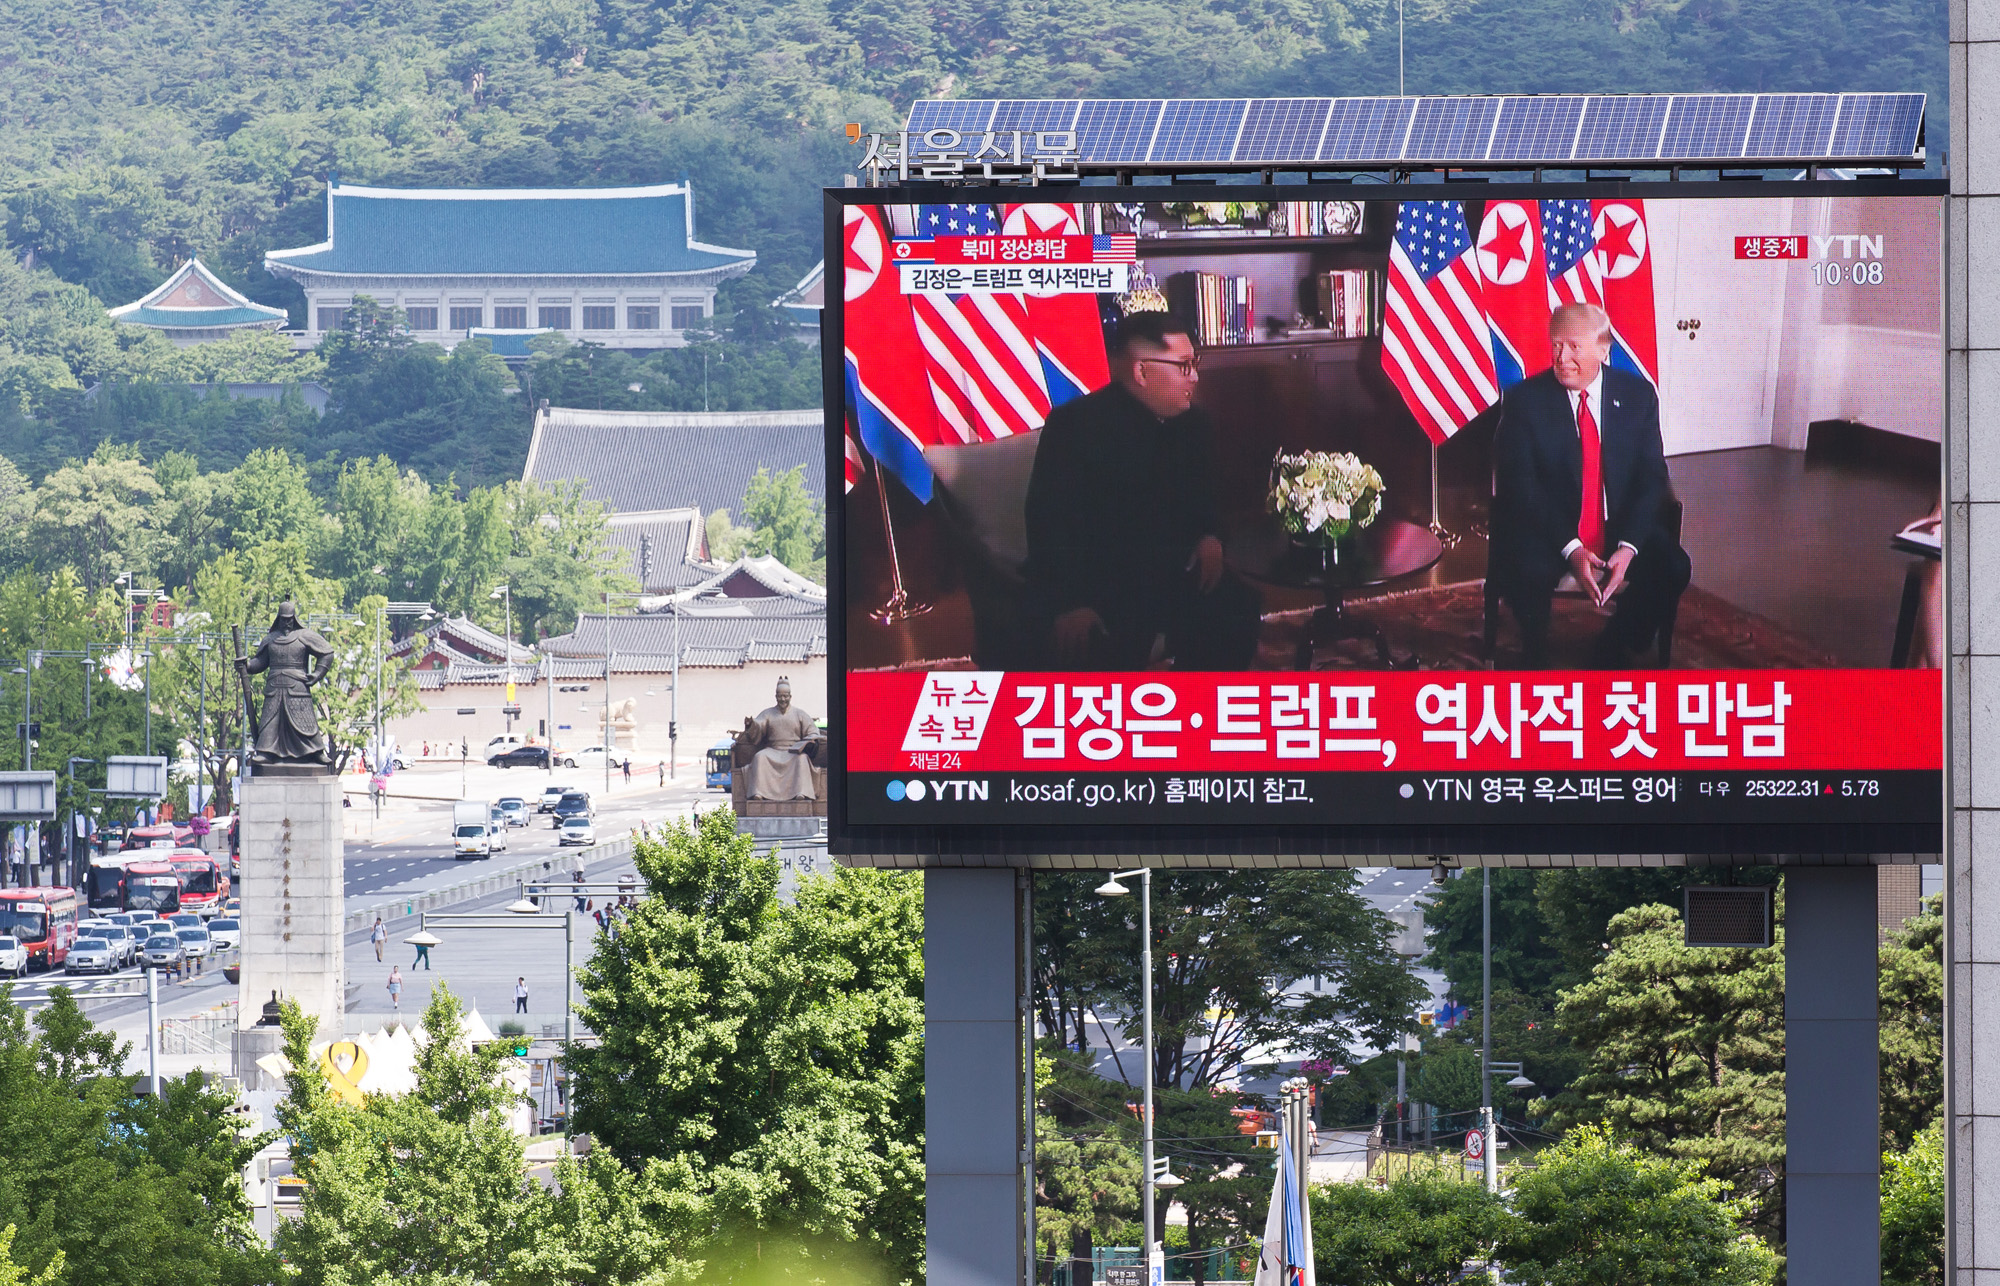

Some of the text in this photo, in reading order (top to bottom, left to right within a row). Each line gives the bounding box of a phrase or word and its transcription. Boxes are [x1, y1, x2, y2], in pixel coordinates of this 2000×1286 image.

[961, 239, 1067, 260] 북미 정상회담
[1743, 238, 1799, 257] 생중계
[1812, 235, 1884, 259] YTN
[912, 267, 1114, 290] 김정은-트럼프 역사적만남
[1811, 262, 1884, 286] 10:08
[930, 679, 989, 707] 뉴스
[918, 715, 978, 743] 속보
[1415, 682, 1584, 759] 역사적
[1602, 681, 1658, 759] 첫
[1677, 681, 1792, 758] 만남
[929, 780, 990, 801] YTN
[1164, 777, 1255, 803] 홈페이지
[1262, 777, 1315, 803] 참고.
[1422, 776, 1677, 803] YTN 영국 옥스퍼드 영어
[1745, 779, 1819, 797] 25322.31
[1841, 779, 1880, 797] 5.78
